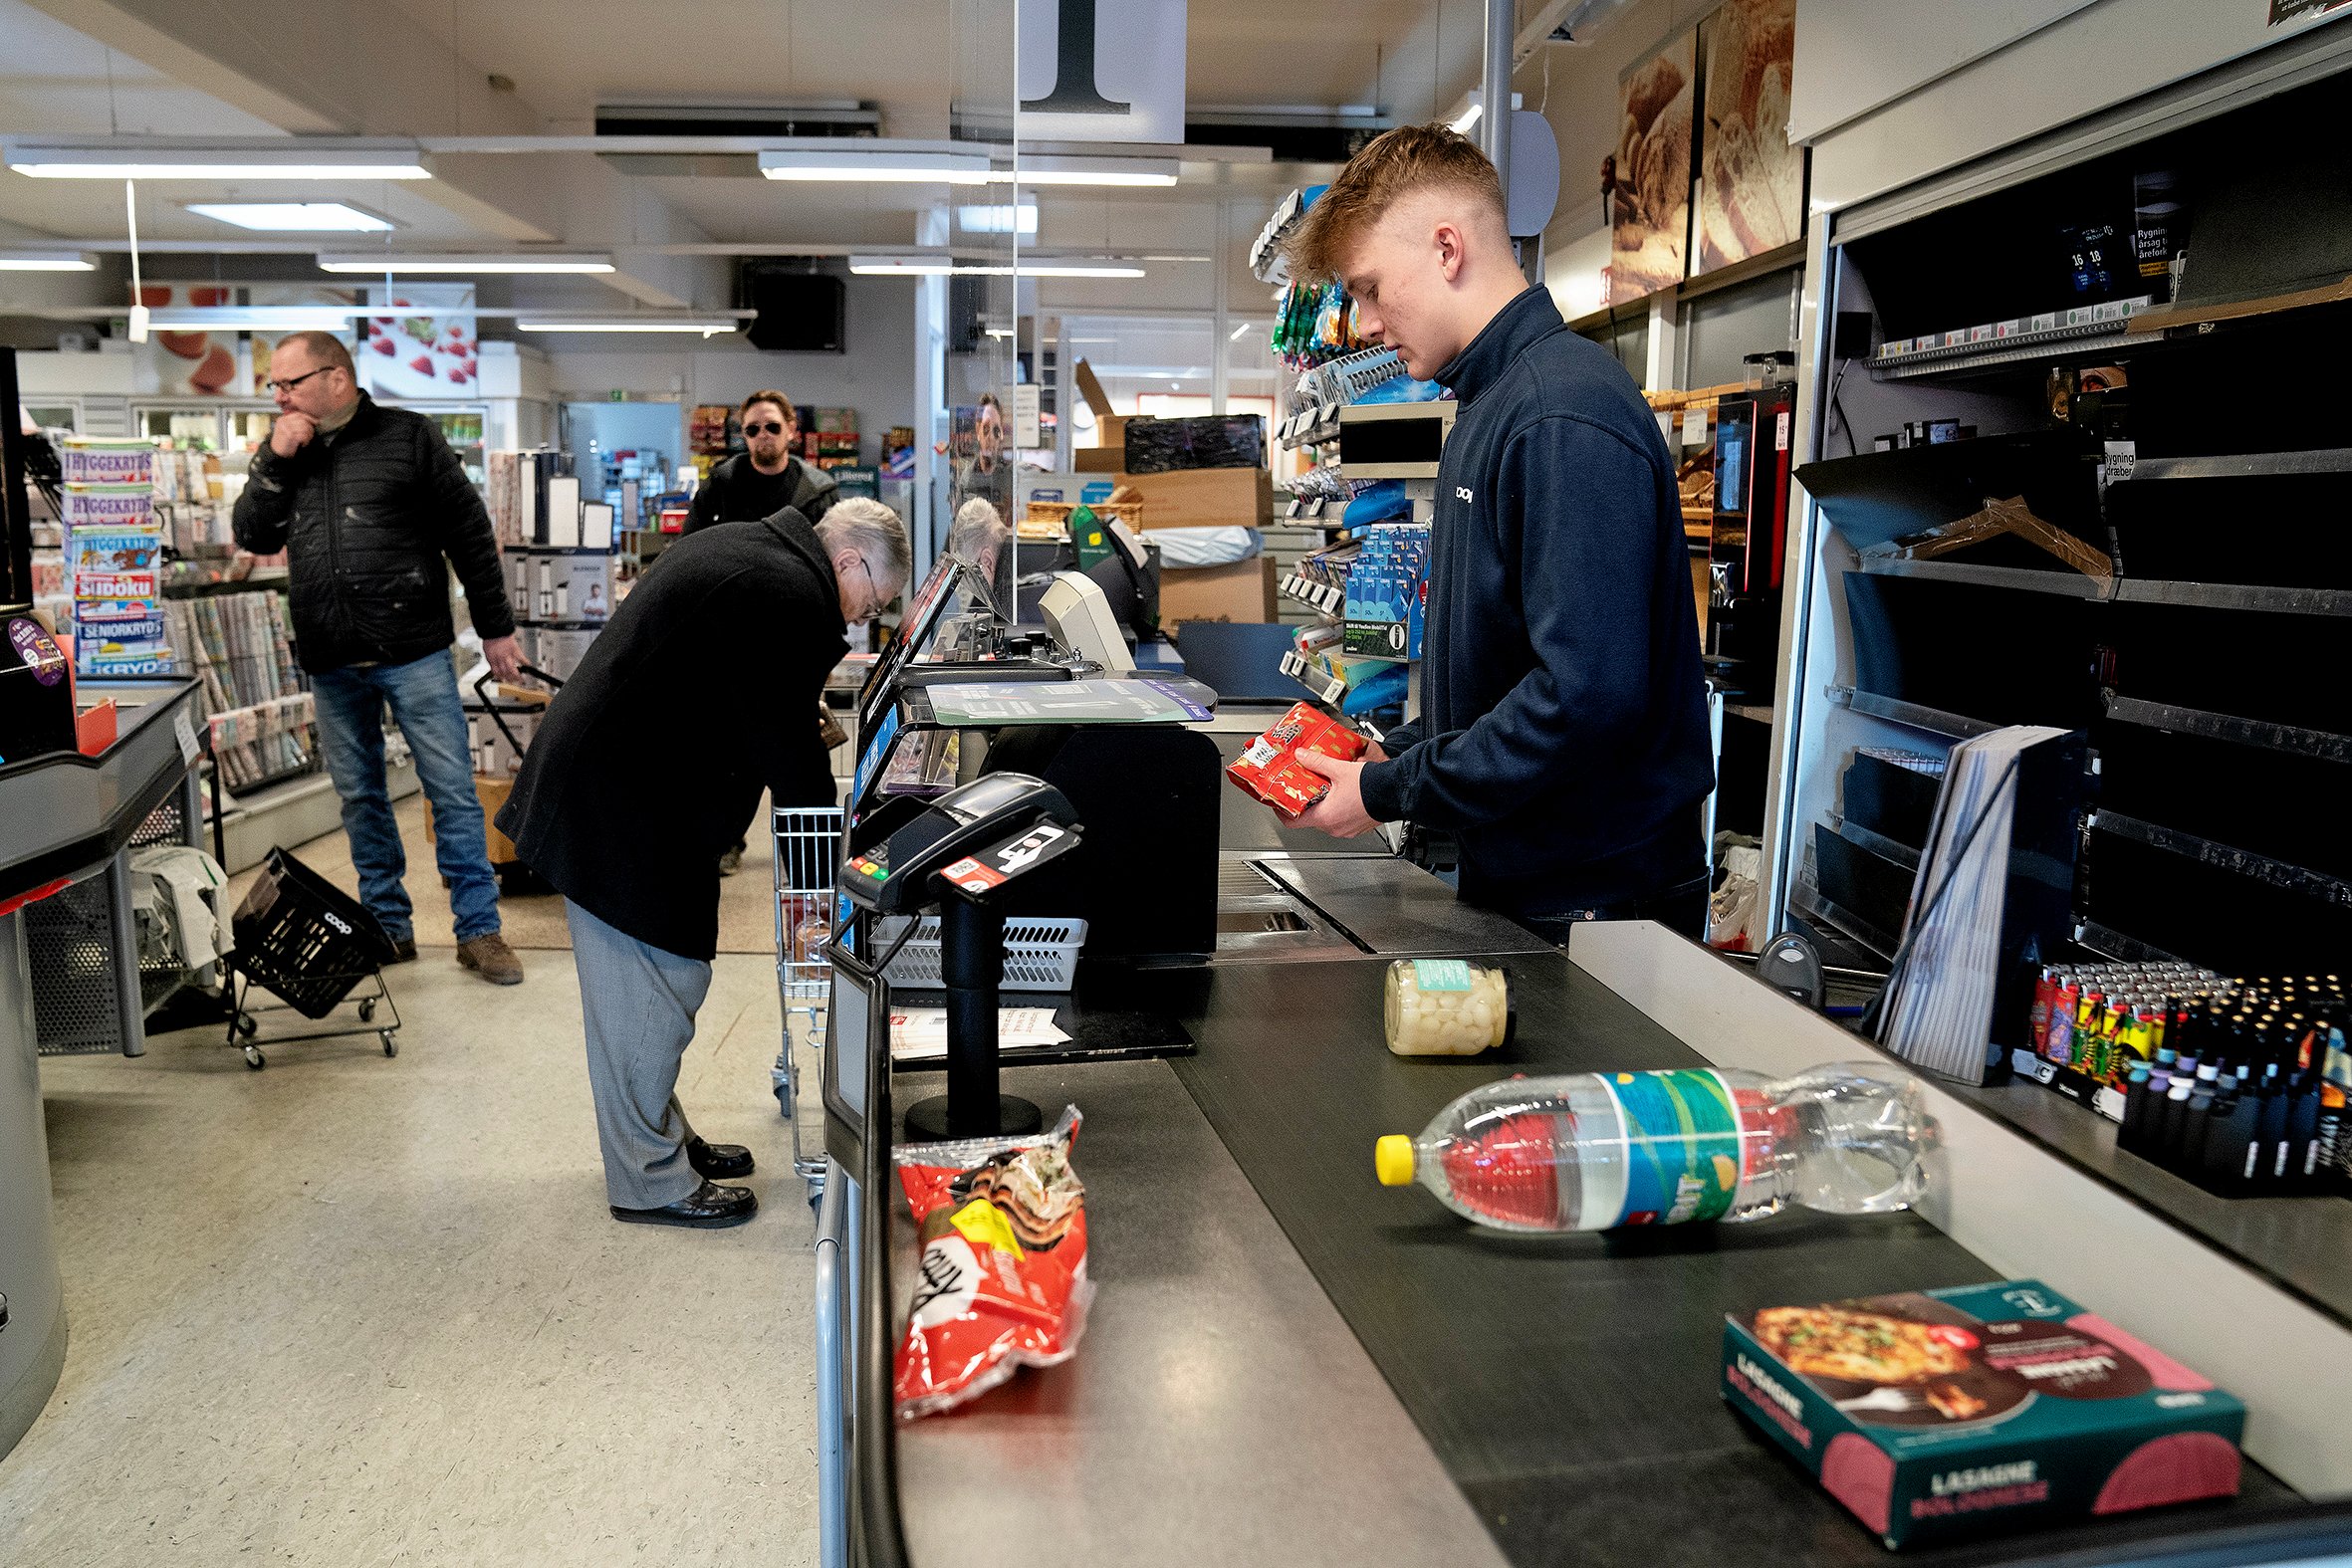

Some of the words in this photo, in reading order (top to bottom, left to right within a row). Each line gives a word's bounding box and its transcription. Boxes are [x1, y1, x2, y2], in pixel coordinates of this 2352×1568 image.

[2072, 254, 2084, 267] 16
[2089, 250, 2102, 263] 18
[73, 496, 151, 515] HYGGEKRYDS
[80, 582, 151, 596] SUDOKU
[324, 912, 353, 935] coop
[1930, 1459, 2038, 1496] LASAGNE
